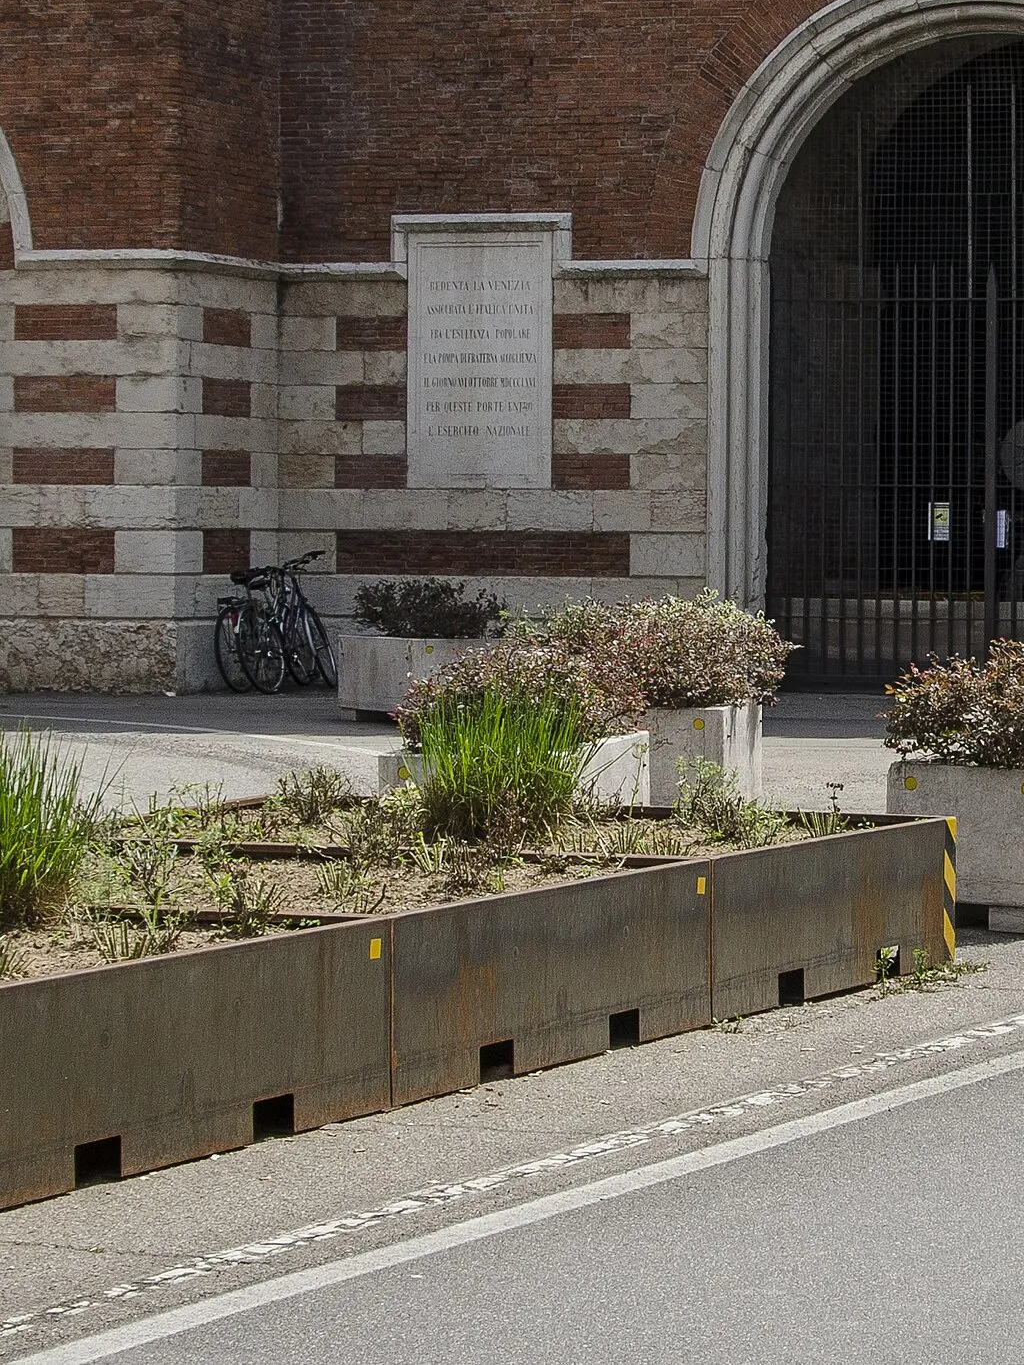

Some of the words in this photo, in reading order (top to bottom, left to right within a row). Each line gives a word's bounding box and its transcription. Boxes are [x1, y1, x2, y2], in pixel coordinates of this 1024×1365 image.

[430, 280, 469, 291] REDENTA
[474, 280, 485, 291] LA
[488, 280, 531, 291] VENEZIA
[427, 304, 466, 315] ASSICURATA
[430, 329, 442, 340] FRA
[495, 329, 531, 340] POPOLARE
[438, 353, 459, 364] POMPA
[467, 353, 498, 364] FRATERNA
[431, 377, 457, 388] GIORNO
[467, 377, 498, 388] OTTOBRE
[426, 401, 440, 412] PER
[444, 401, 472, 412] QUESTE
[477, 401, 503, 412] PORTE
[437, 425, 479, 437] ESERCITO
[486, 425, 530, 437] NAZIONALE
